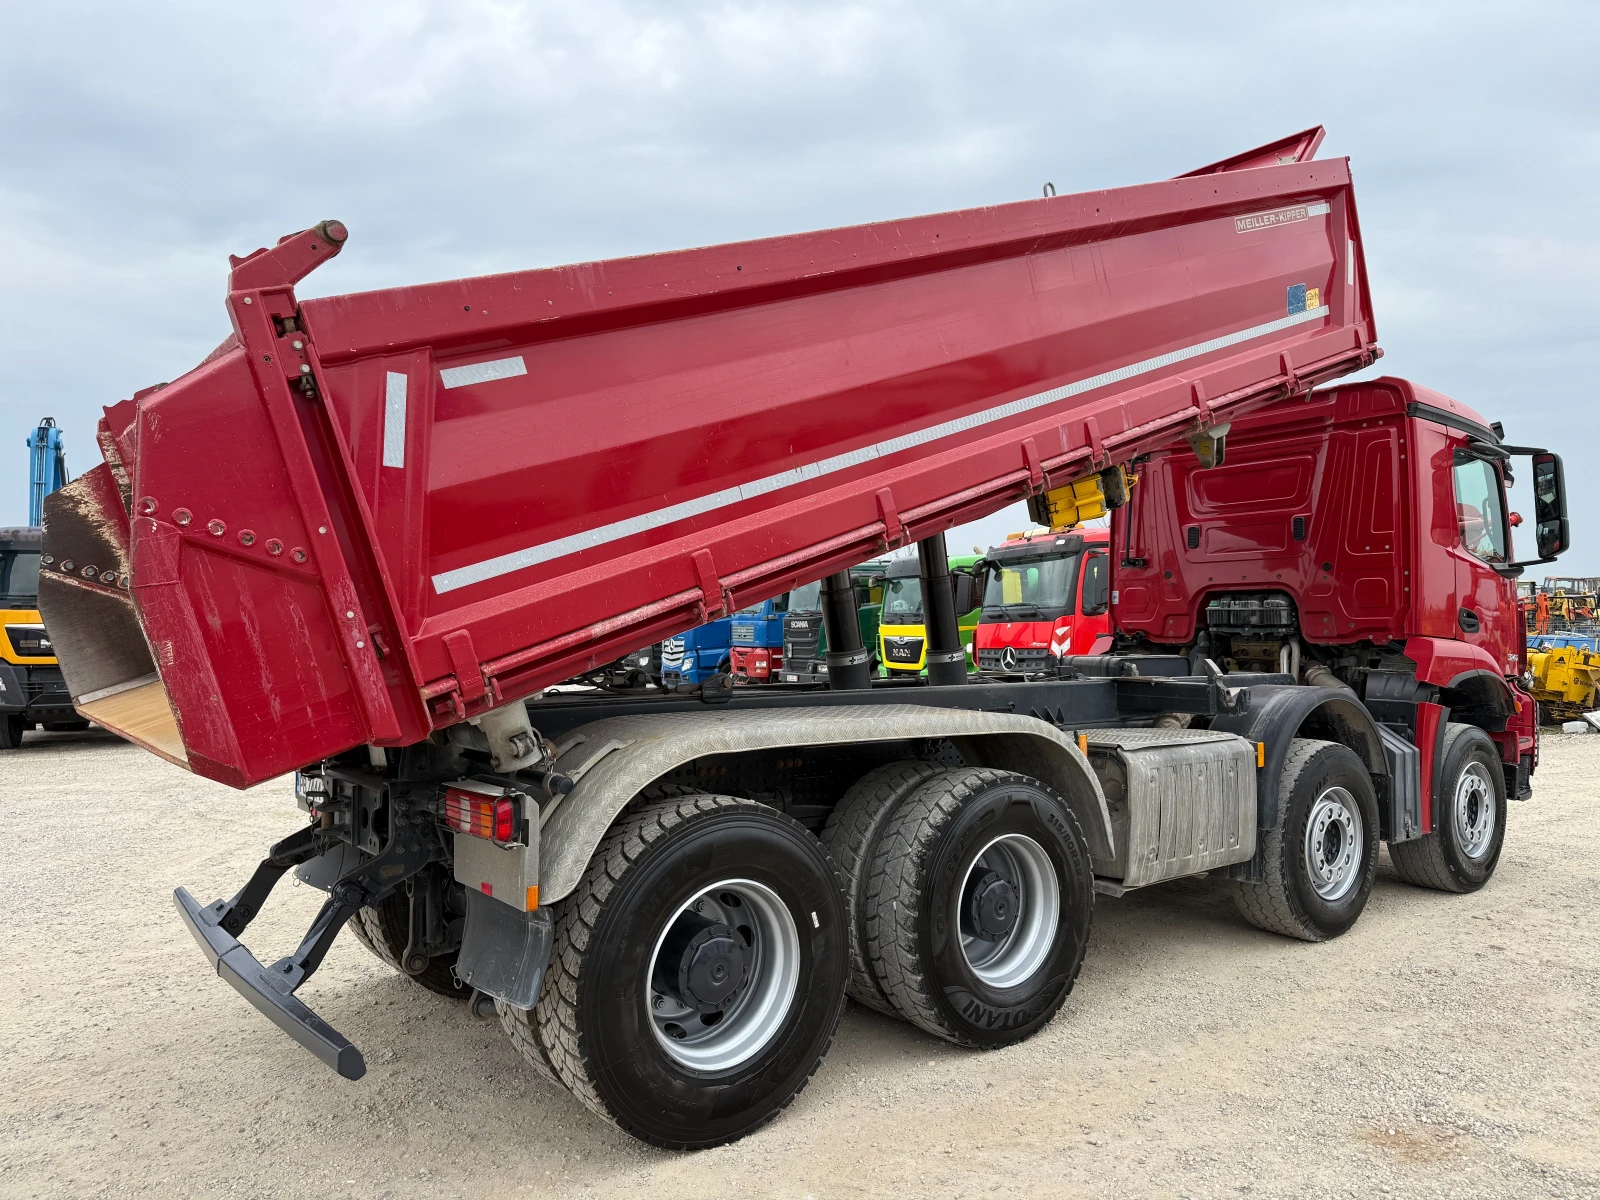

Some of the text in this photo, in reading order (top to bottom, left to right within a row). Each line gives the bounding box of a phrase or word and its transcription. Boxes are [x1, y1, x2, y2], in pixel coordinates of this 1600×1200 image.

[1237, 208, 1306, 230] MEILLER-KIPPER
[892, 648, 911, 657] MAN
[962, 999, 1028, 1028] OTANI
